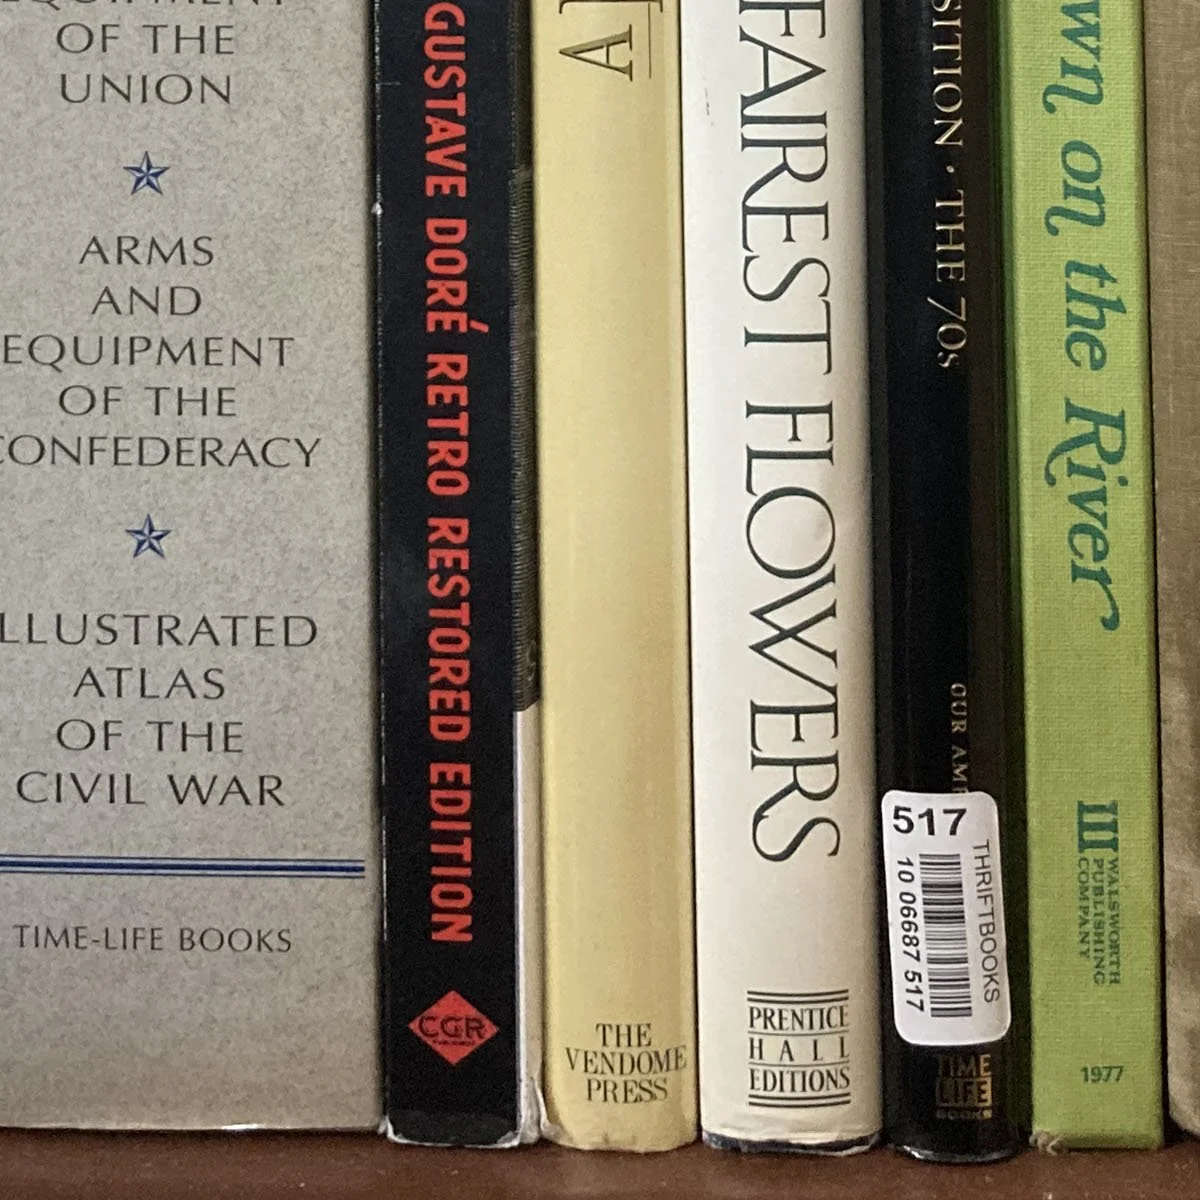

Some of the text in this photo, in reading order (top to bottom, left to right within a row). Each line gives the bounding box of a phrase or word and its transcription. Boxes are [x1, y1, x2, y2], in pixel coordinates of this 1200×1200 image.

[56, 22, 235, 55] OF THE
[558, 23, 634, 82] A
[60, 73, 232, 105] UNION
[423, 1, 468, 198] GUSTAVE
[1044, 140, 1107, 238] on
[78, 235, 215, 266] ARMS
[934, 188, 966, 282] THE
[425, 217, 490, 334] DORÉ
[91, 286, 202, 316] AND
[1064, 262, 1128, 372] the
[3, 334, 296, 373] EQUIPMENT
[58, 385, 237, 417] OF THE
[426, 354, 470, 496] RETRO
[1045, 397, 1128, 632] River
[427, 517, 471, 742] RESTORED
[745, 400, 841, 862] FLOWERS
[73, 666, 226, 700] ATLAS
[950, 682, 968, 734] OUR
[55, 718, 244, 753] OF THE
[16, 771, 286, 807] CIVIL WAR
[892, 805, 968, 837] 517
[430, 762, 474, 942] EDITION
[972, 838, 1001, 1004] THRIFTBOOKS
[1077, 856, 1091, 960] COMPANY
[1092, 857, 1106, 987] PUBLISHING
[1107, 856, 1121, 985] WALSWORTH
[12, 924, 292, 953] TIME-LIFE BOOKS
[896, 857, 925, 1013] 10 06687 517
[594, 1023, 652, 1048] THE
[749, 1004, 849, 1032] PRENTICE
[564, 1045, 688, 1077] VENDOME
[749, 1036, 849, 1062] HALL
[586, 1077, 668, 1105] PRESS
[750, 1066, 850, 1093] EDITIONS
[1081, 1065, 1125, 1083] 1977
